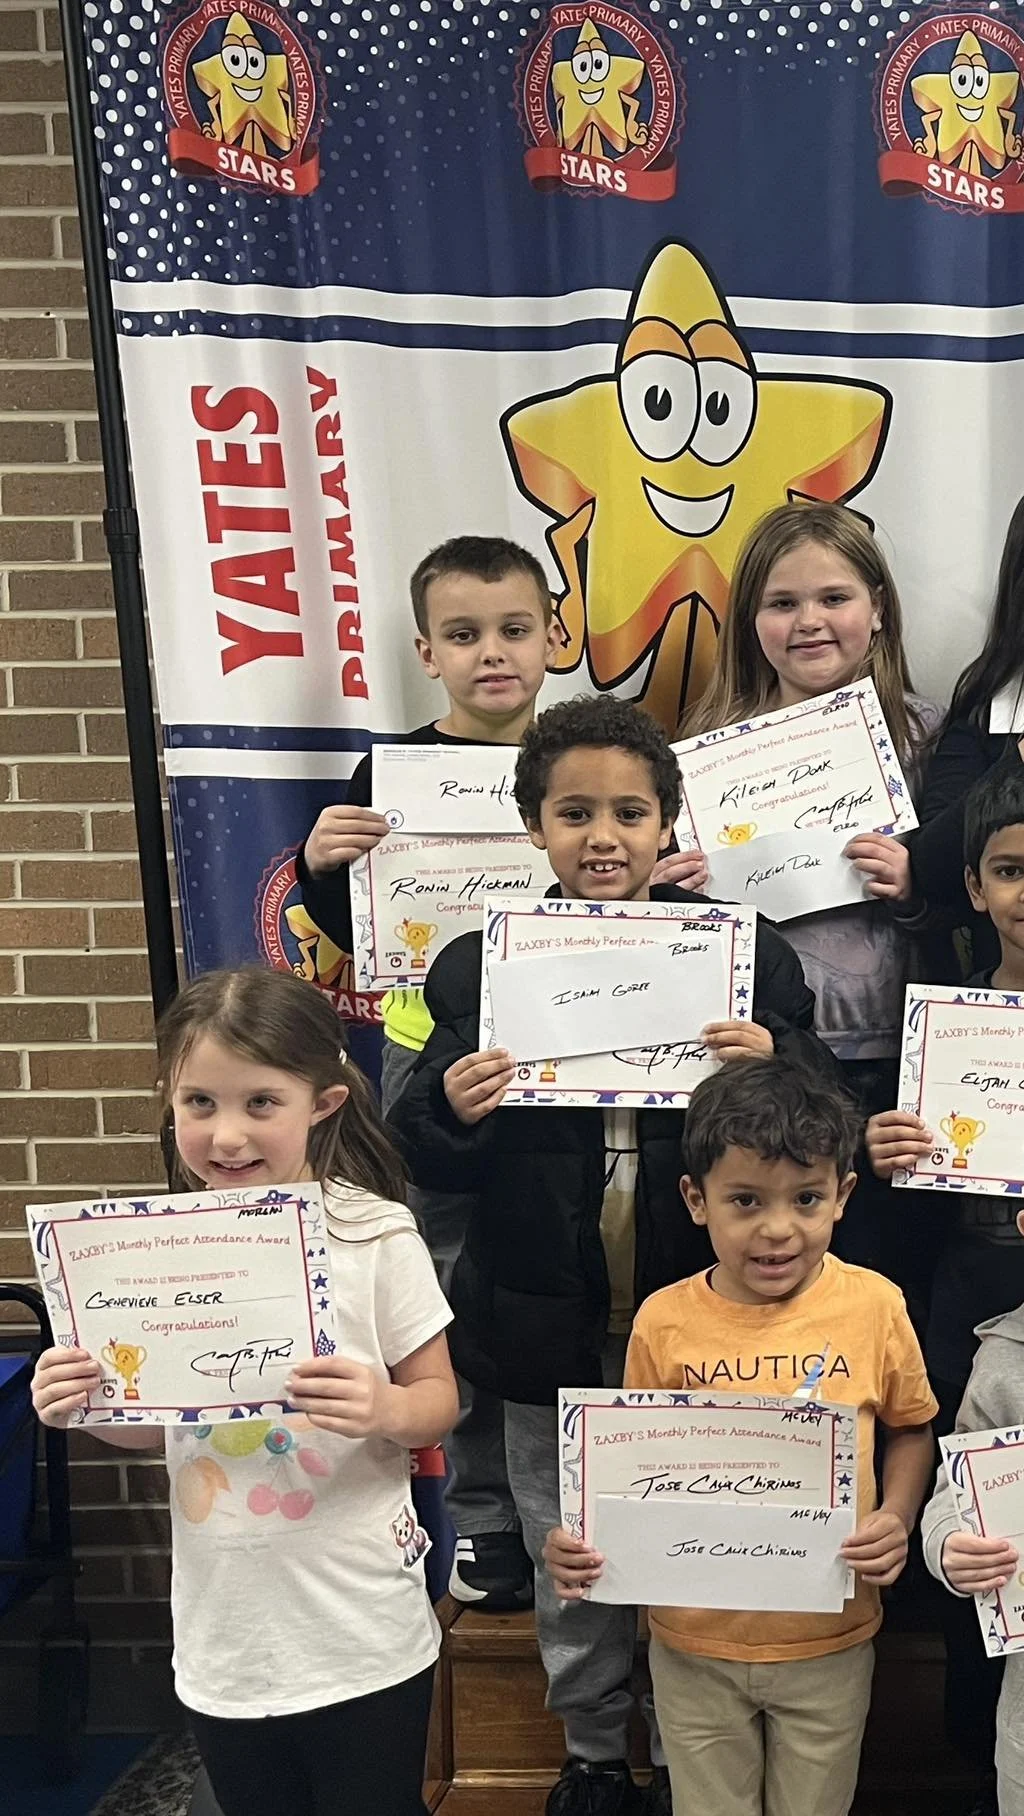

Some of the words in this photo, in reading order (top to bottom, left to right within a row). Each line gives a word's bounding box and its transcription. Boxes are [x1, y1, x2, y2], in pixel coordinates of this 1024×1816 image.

[590, 6, 645, 42] PRIMARY
[932, 20, 969, 36] YATES
[973, 19, 1020, 53] PRIMARY
[169, 25, 199, 75] PRIMARY
[288, 47, 309, 88] YATES
[887, 39, 920, 96] PRIMARY
[651, 55, 669, 97] YATES
[168, 77, 189, 119] YATES
[529, 96, 548, 137] YATES
[641, 101, 669, 158] PRIMARY
[885, 100, 901, 140] YATES
[217, 147, 296, 191] STARS
[561, 153, 627, 192] STARS
[927, 163, 1005, 209] STARS
[191, 385, 304, 676] YATES
[306, 365, 369, 700] PRIMARY
[751, 783, 830, 811] Congratulations!
[265, 871, 291, 922] PRIMARY
[265, 928, 282, 964] YATES
[515, 938, 561, 951] ZAXBY'S
[564, 936, 600, 947] Monthly
[603, 936, 636, 947] Perfect
[322, 987, 383, 1019] TARS
[935, 1027, 978, 1040] ZAXBY'S
[981, 1026, 1015, 1038] Monthly
[69, 1242, 115, 1262] ZAXBY'S
[117, 1238, 152, 1251] Monthly
[155, 1236, 190, 1249] Perfect
[193, 1234, 252, 1245] Attendance
[256, 1234, 290, 1245] Award
[141, 1316, 239, 1335] Congratulations!
[684, 1354, 850, 1386] NAUTICA
[594, 1430, 644, 1446] ZAXBY'S
[648, 1426, 687, 1439] Monthly
[691, 1425, 726, 1436] Perfect
[730, 1427, 786, 1441] Attendance
[790, 1434, 821, 1447] Award
